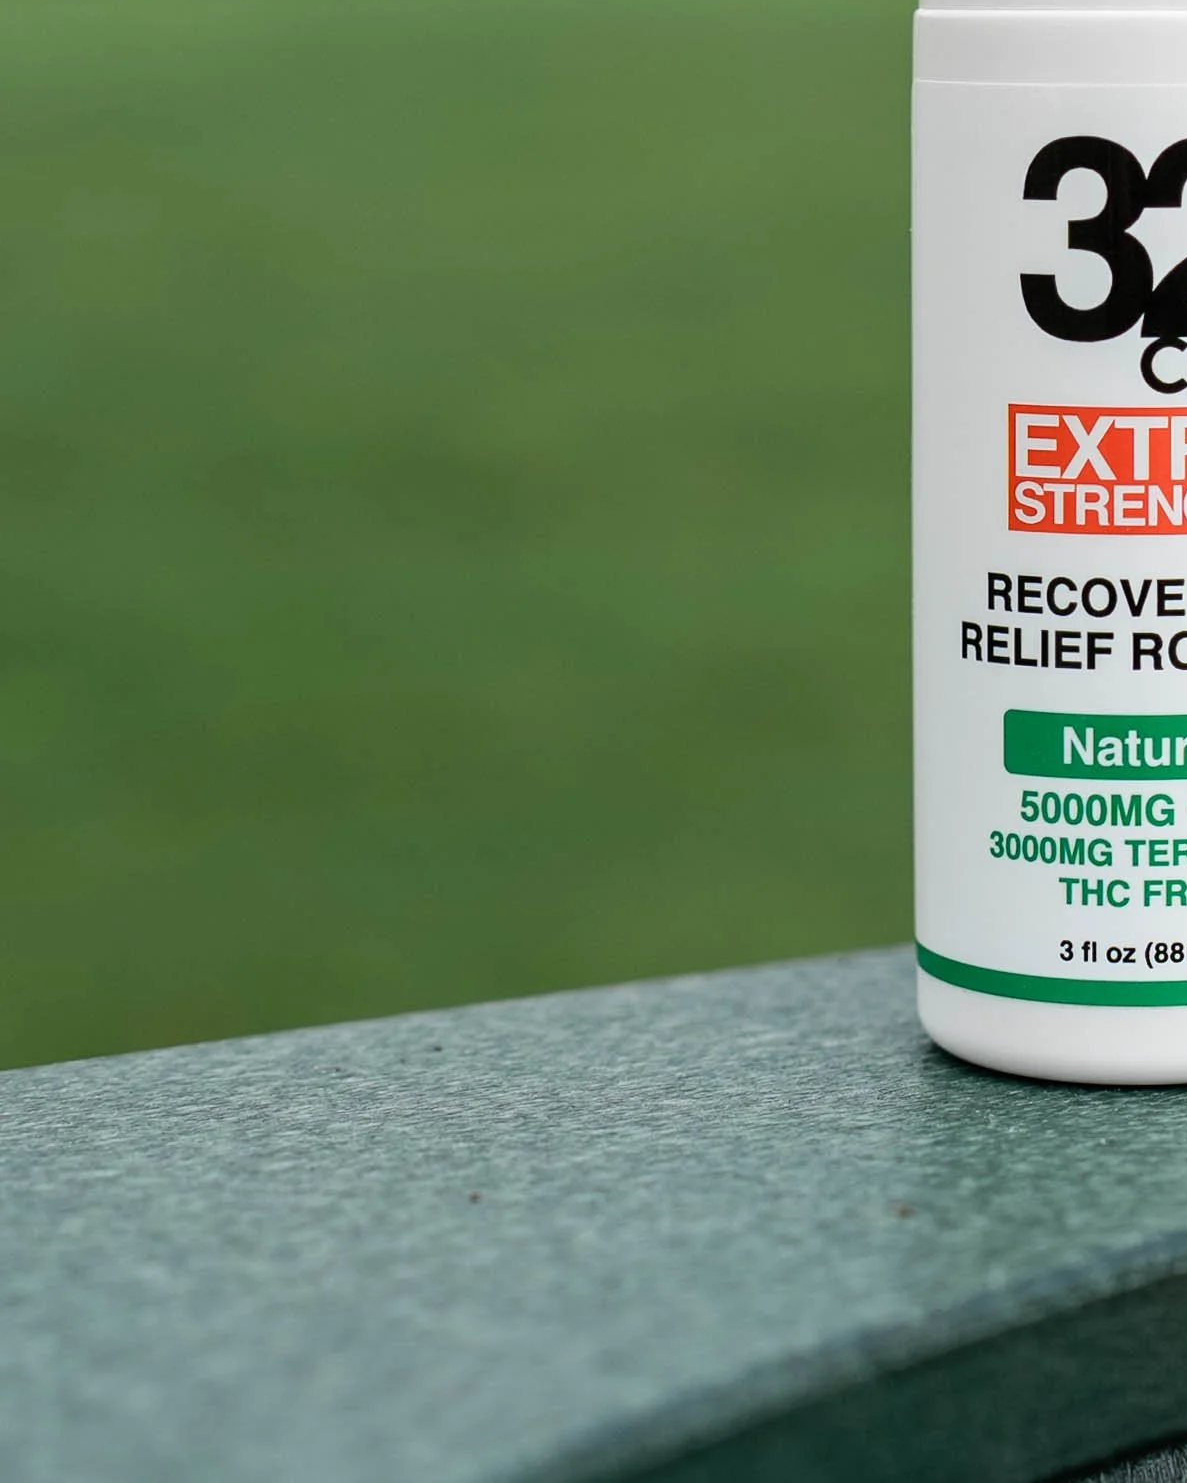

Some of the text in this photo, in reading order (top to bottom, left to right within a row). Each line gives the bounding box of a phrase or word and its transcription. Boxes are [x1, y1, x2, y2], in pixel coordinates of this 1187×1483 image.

[961, 621, 1114, 669] RELIEF
[1021, 791, 1175, 826] 5000MG
[990, 831, 1112, 866] 3000MG
[1059, 877, 1130, 907] THC
[1059, 940, 1073, 961] 3
[1081, 941, 1096, 962] fl
[1106, 946, 1136, 964] oz
